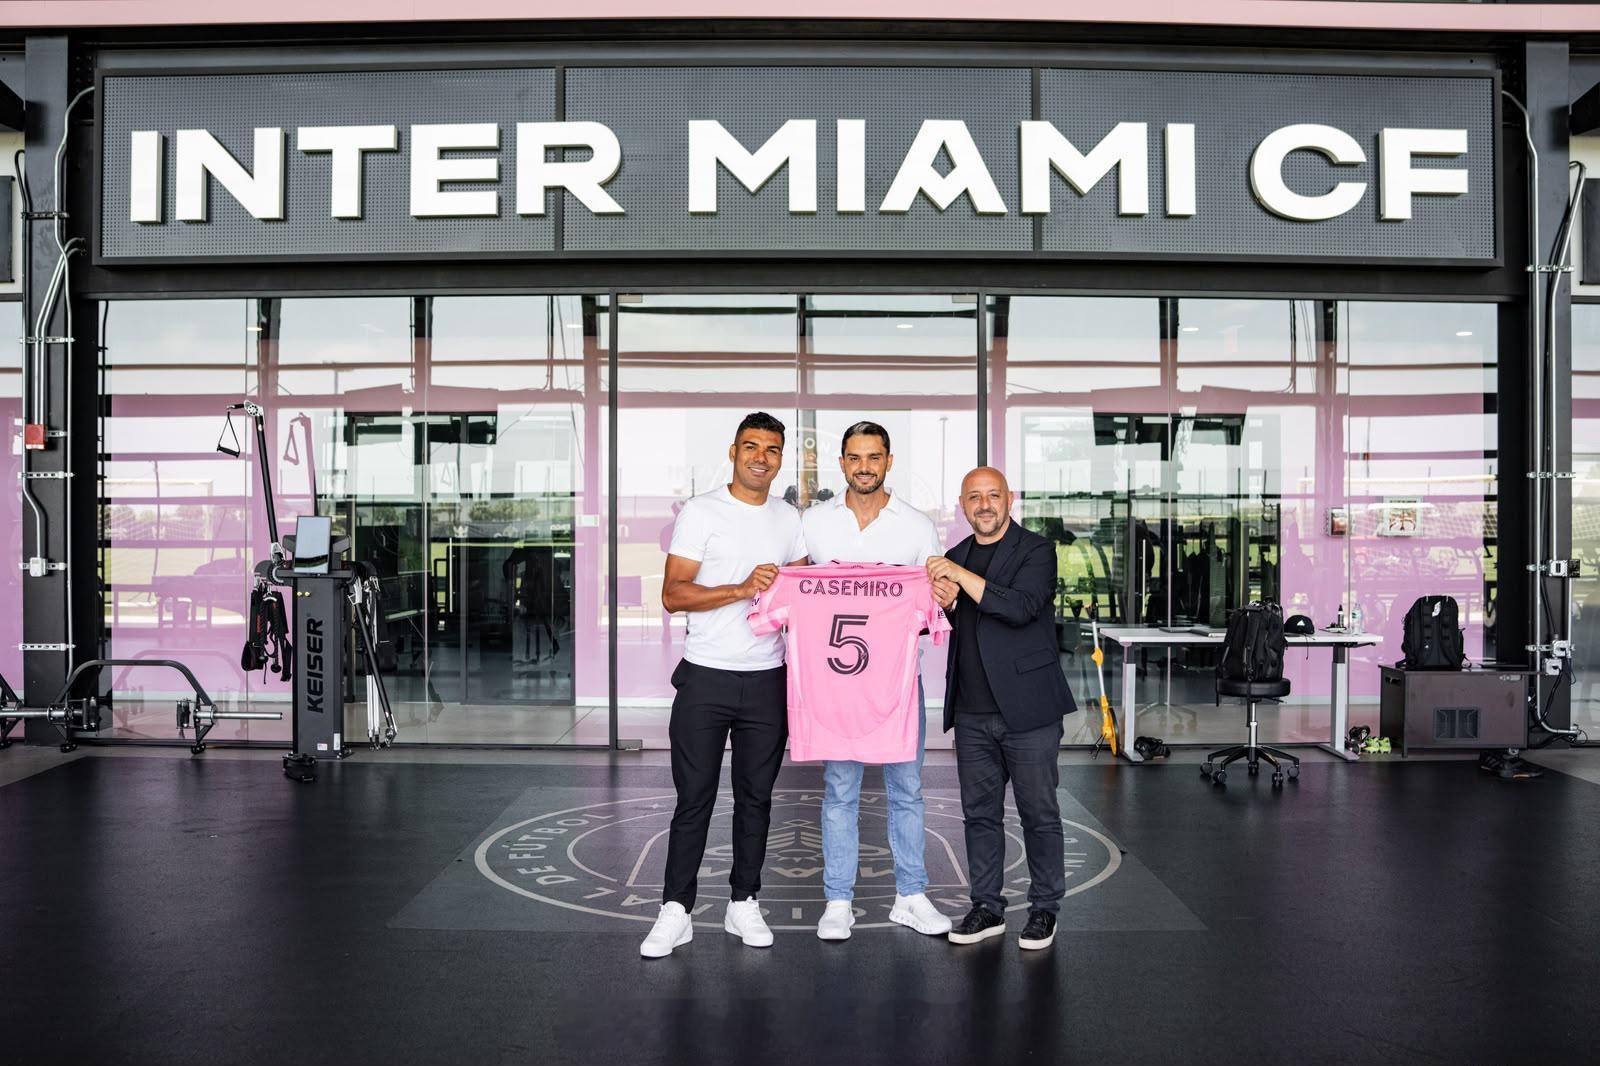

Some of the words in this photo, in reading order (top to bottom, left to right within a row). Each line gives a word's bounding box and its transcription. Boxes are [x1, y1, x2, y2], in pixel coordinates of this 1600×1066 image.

[130, 120, 625, 223] INTER
[688, 119, 1196, 216] MIAMI
[1249, 123, 1469, 221] CF
[799, 579, 904, 597] CASEMIRO
[306, 617, 324, 714] KEISER
[827, 614, 869, 676] 5
[502, 813, 615, 860] FÚTBOL
[517, 864, 578, 886] DE
